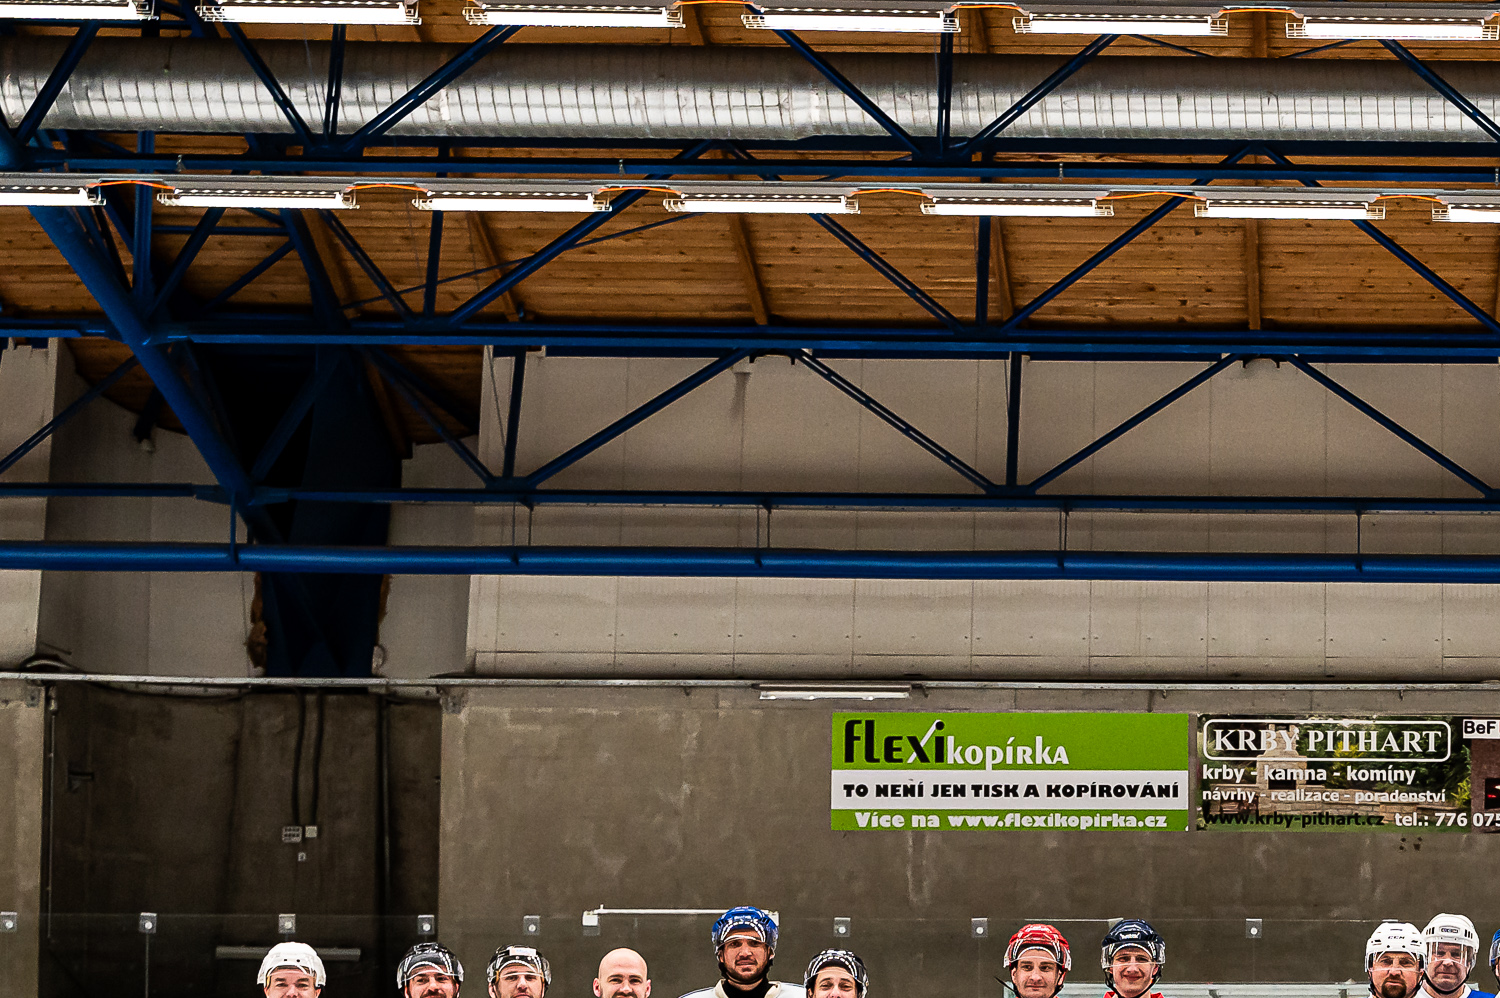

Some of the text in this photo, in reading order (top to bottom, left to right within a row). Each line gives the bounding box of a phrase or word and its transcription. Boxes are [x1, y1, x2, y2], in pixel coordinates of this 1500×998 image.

[1464, 719, 1497, 736] BeF
[1213, 728, 1443, 753] KRBY PITHART
[1202, 764, 1245, 783] krby
[1264, 764, 1327, 781] kamna
[1346, 764, 1417, 784] komíny
[843, 780, 1180, 798] TO NENÍ JEN TISK A KOPÍROVÁNÍ
[1202, 788, 1257, 804] návrhy
[1271, 788, 1340, 802] realizace
[1354, 788, 1447, 804] poradenství
[855, 811, 1168, 831] Více na www.flexikopirka.cz
[1203, 810, 1386, 829] www.krby-pithart.cz
[1395, 812, 1430, 827] tel.:
[1435, 812, 1469, 828] 776
